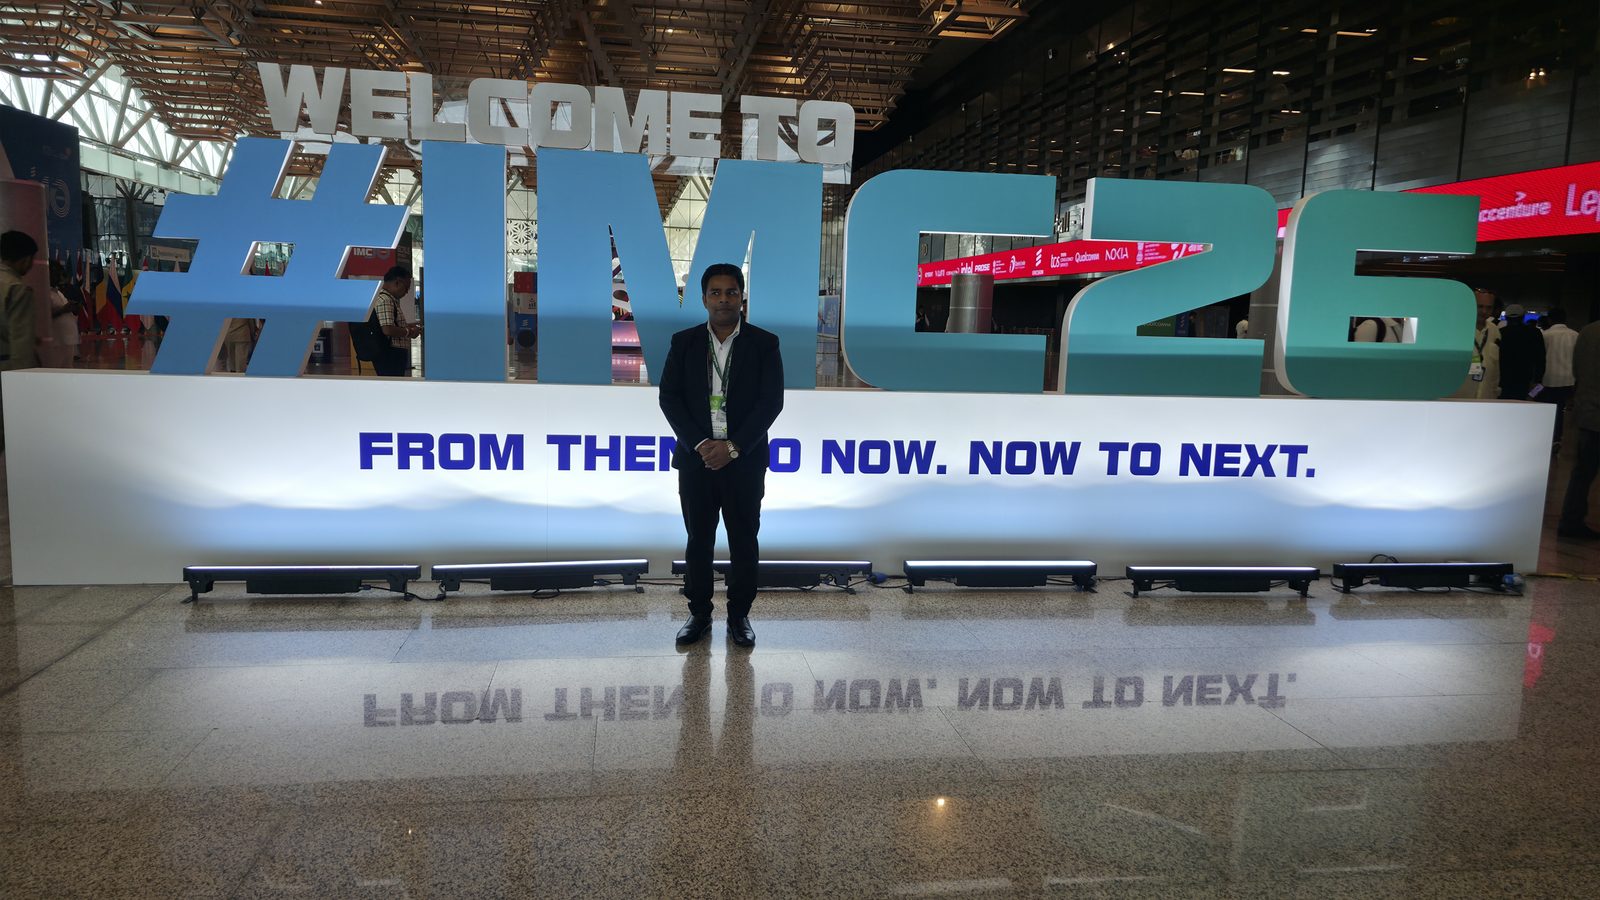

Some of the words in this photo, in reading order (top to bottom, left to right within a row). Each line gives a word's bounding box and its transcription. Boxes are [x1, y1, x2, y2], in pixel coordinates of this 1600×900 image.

[257, 62, 722, 158] WELCOME
[740, 94, 855, 165] TO
[1105, 247, 1128, 260] NOKIA
[359, 432, 524, 470] FROM
[768, 438, 801, 472] O
[821, 439, 947, 475] NOW.
[969, 440, 1081, 475] NOW
[1099, 442, 1161, 476] TO
[1179, 443, 1316, 478] NEXT.
